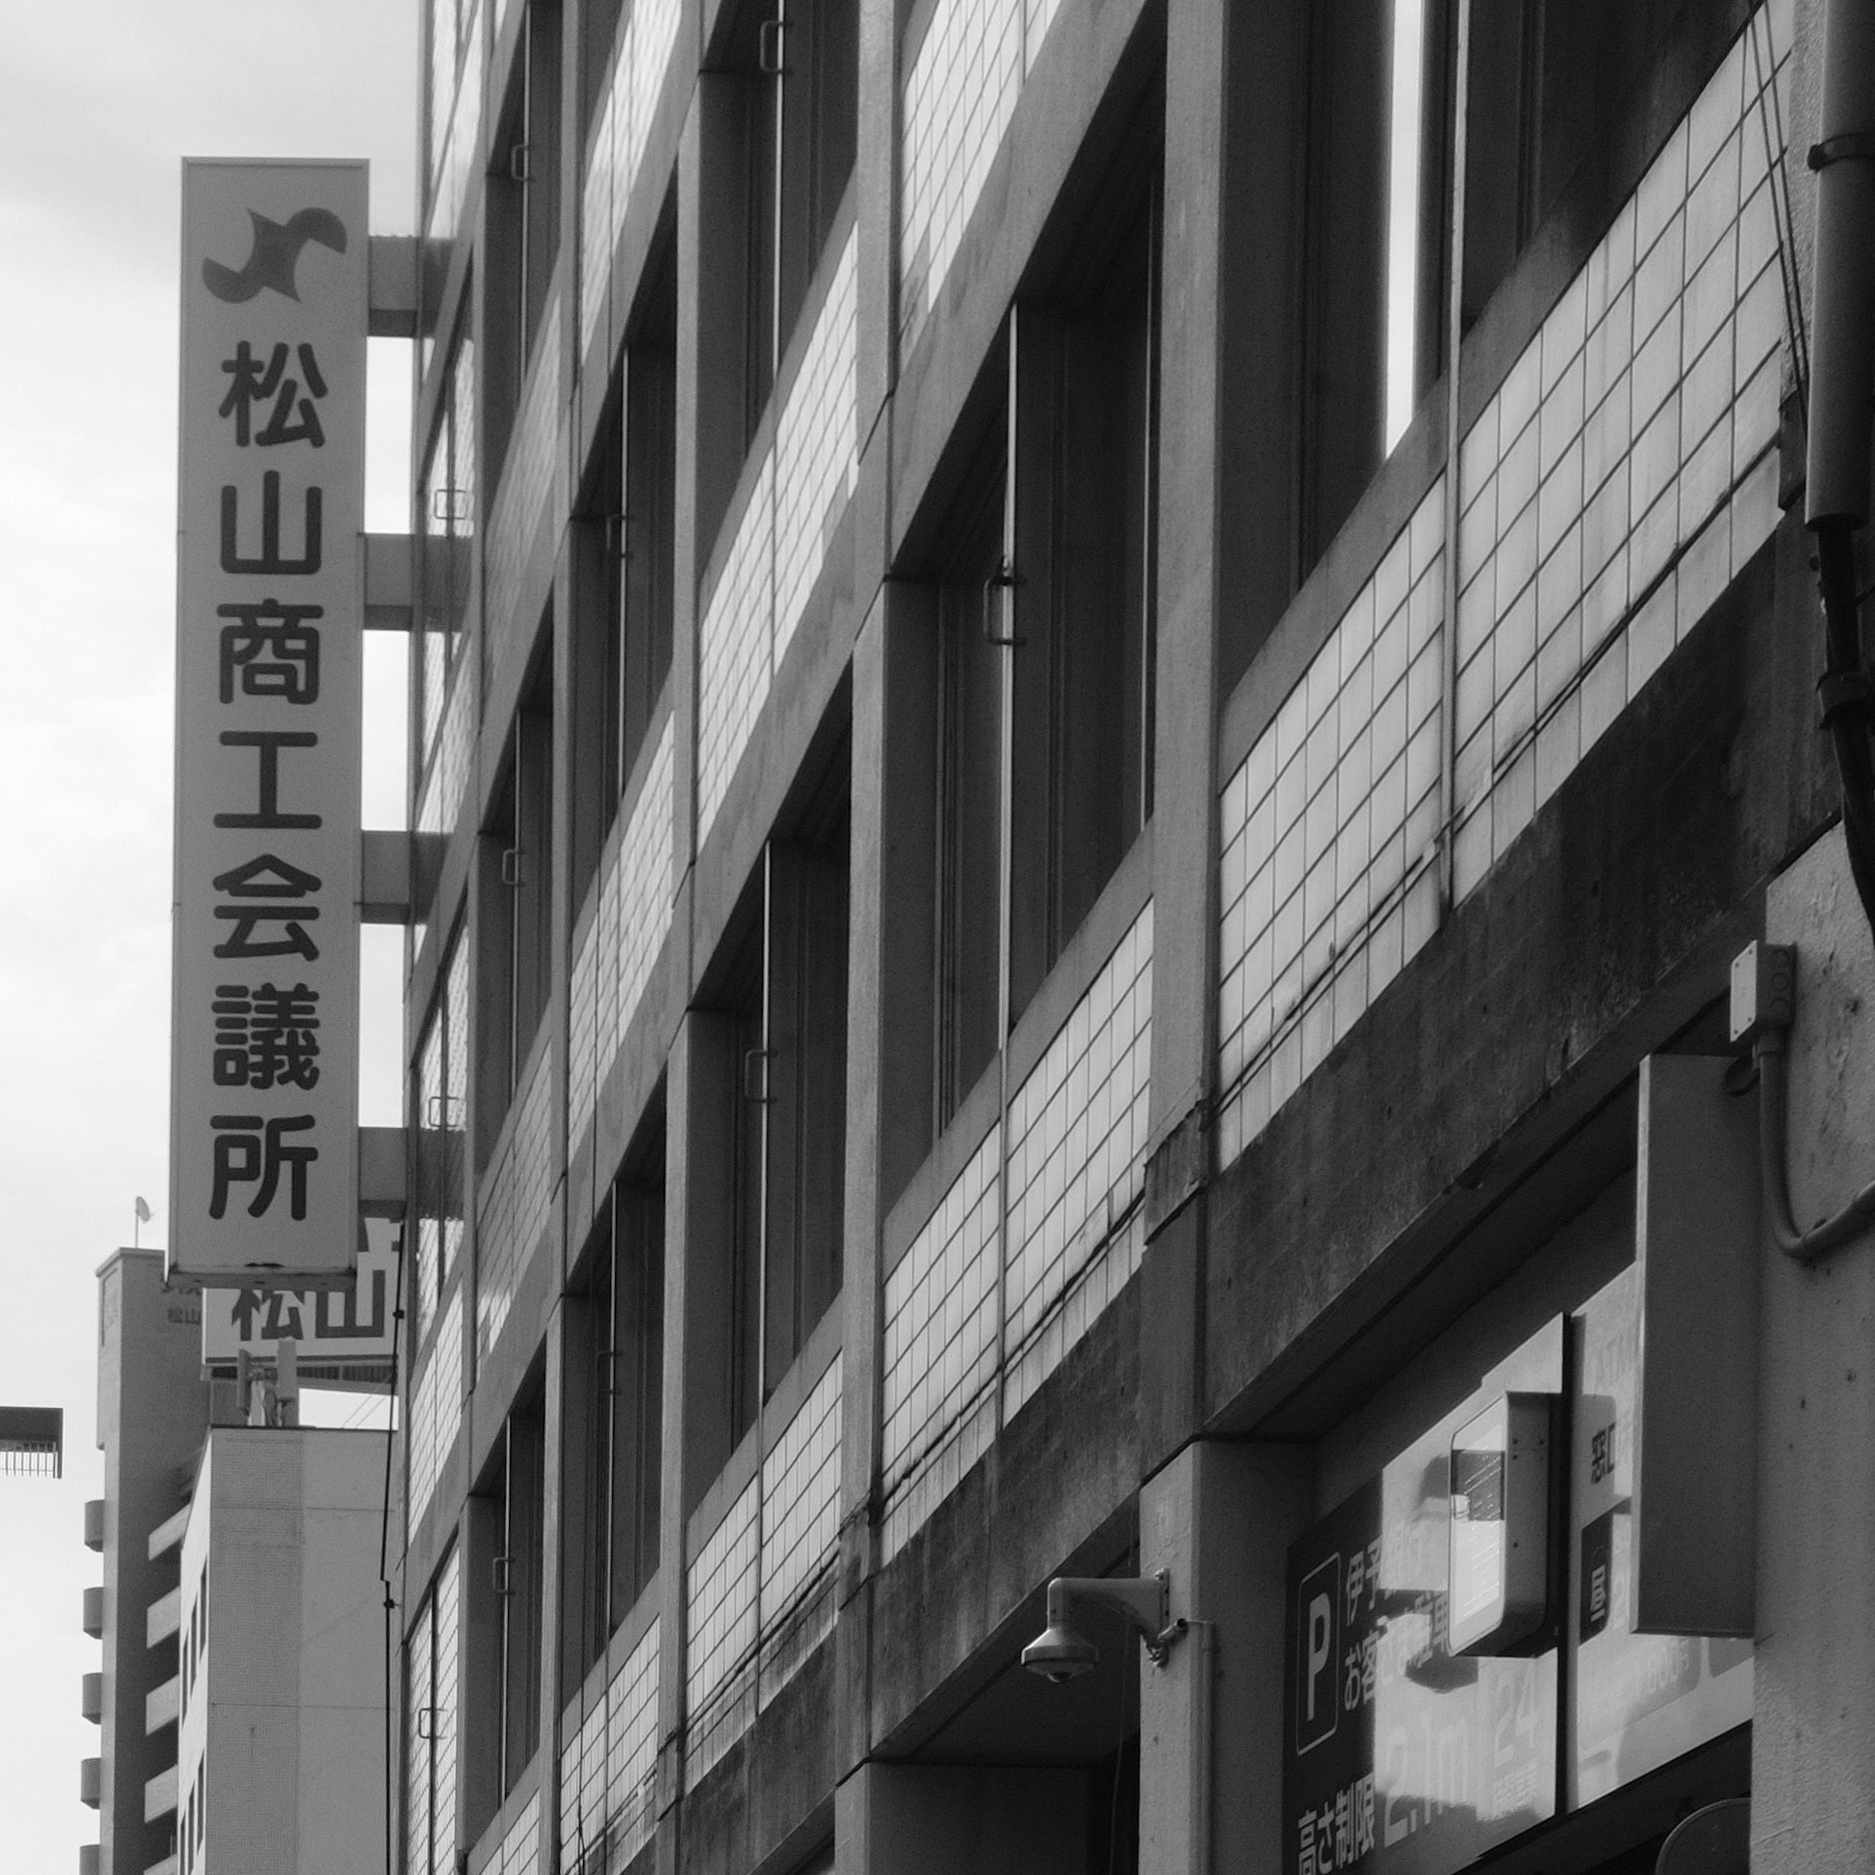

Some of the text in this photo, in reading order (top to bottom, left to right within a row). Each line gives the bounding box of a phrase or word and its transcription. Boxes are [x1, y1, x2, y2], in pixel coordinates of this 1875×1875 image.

[209, 340, 328, 1222] 松山商工会議所
[230, 1268, 386, 1342] 松山
[1308, 1592, 1331, 1721] P
